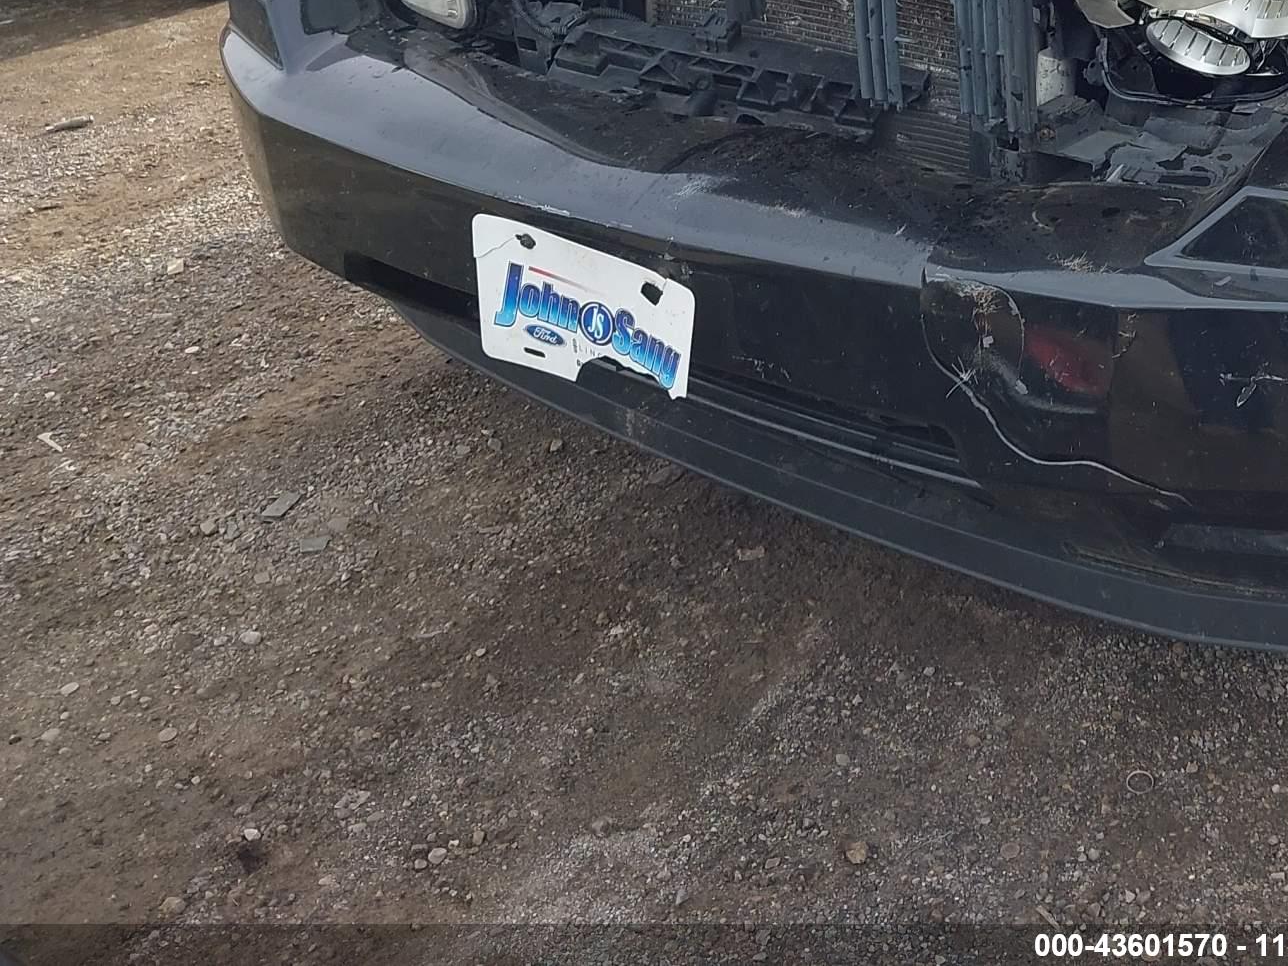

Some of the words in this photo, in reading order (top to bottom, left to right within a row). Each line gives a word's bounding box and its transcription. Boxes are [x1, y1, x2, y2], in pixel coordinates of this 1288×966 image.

[493, 261, 580, 334] John
[611, 307, 682, 390] Sany
[533, 326, 558, 344] Ford
[588, 305, 605, 340] JS
